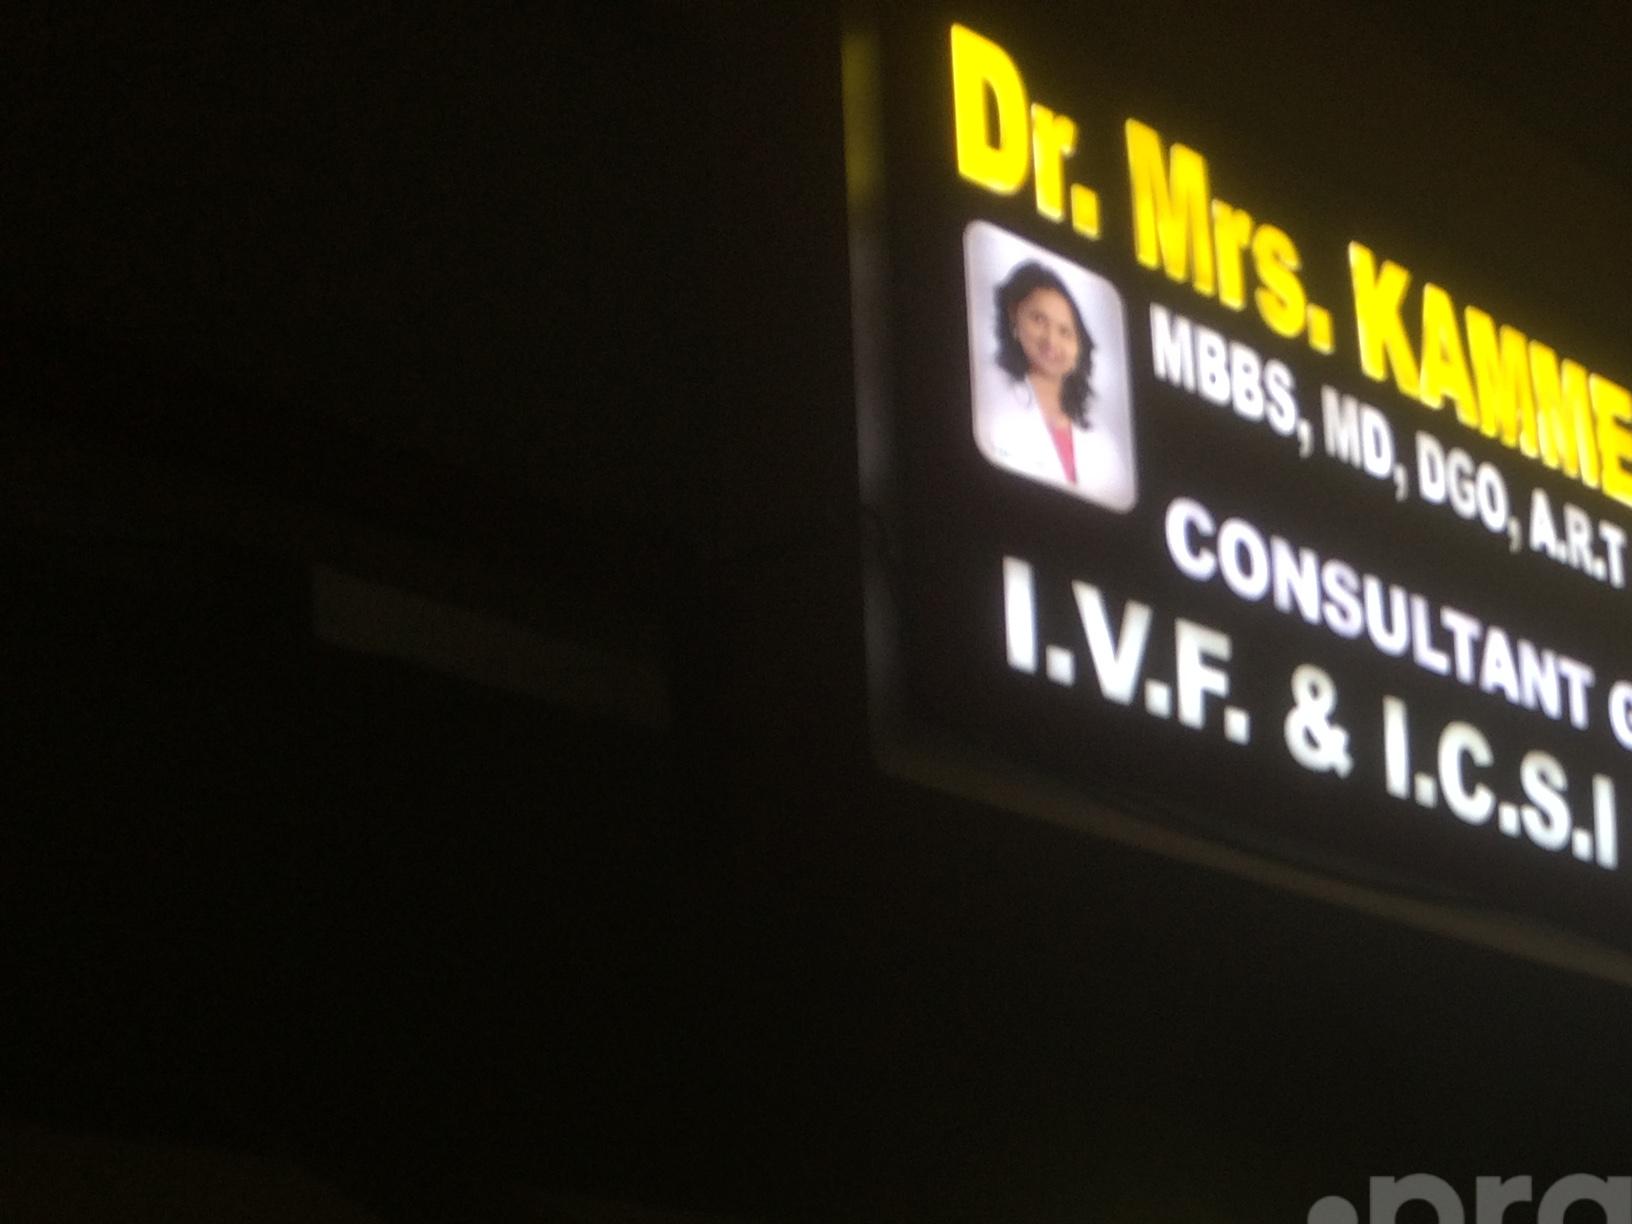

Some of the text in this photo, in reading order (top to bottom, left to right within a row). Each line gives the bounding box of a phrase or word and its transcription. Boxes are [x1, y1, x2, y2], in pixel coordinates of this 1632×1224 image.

[950, 22, 1101, 241] Dr.
[1124, 117, 1334, 355] Mrs.
[1149, 302, 1311, 458] MBBS,
[1321, 384, 1409, 502] MD,
[1415, 430, 1522, 553] DGO,
[1529, 487, 1627, 590] A.R.T
[1002, 555, 1252, 747] I.V.F.
[1283, 664, 1354, 779] &
[1382, 696, 1619, 870] I.C.S.I
[1164, 497, 1595, 730] CONSULTANT
